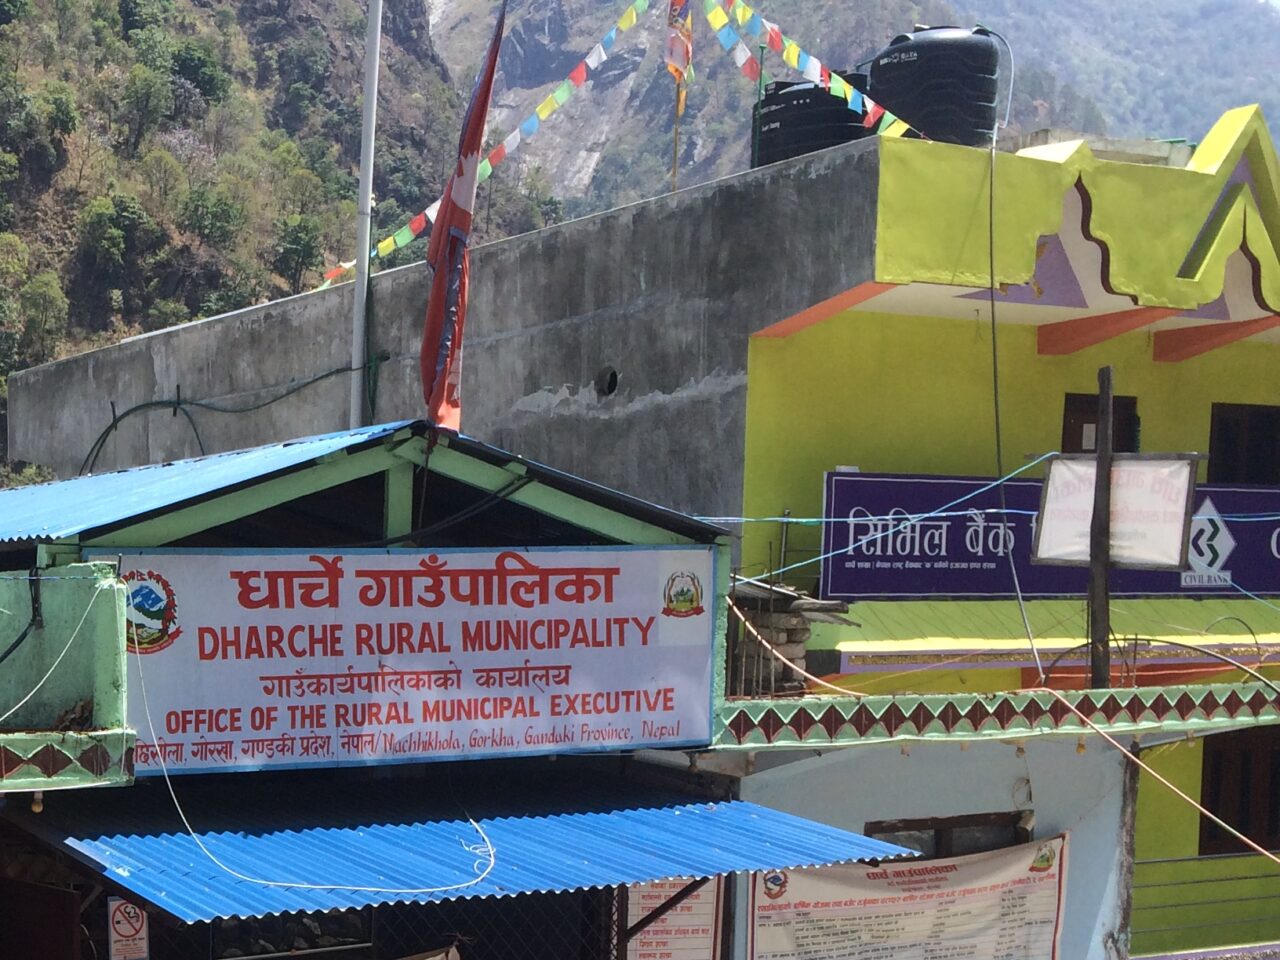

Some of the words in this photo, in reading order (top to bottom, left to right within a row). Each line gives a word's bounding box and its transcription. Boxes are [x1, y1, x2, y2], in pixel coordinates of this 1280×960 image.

[847, 506, 951, 556] सिभिल
[965, 507, 1016, 556] बैंक
[229, 554, 344, 609] धार्चे
[355, 551, 620, 608] गाउँपालिका
[1183, 574, 1205, 585] CIVIL
[1207, 574, 1229, 585] BANK
[197, 624, 344, 661] DHARCHE
[355, 621, 451, 656] RURAL
[461, 616, 656, 653] MUNICIPALITY
[472, 659, 572, 694] कार्यालय
[165, 708, 242, 735] OFFICE
[250, 706, 278, 731] OF
[287, 704, 326, 730] THE
[334, 702, 414, 728] RURAL
[422, 695, 540, 724] MUNICIPAL
[550, 688, 675, 717] EXECUTIVE
[524, 724, 574, 745] Gandaki
[642, 719, 680, 742] Nepal
